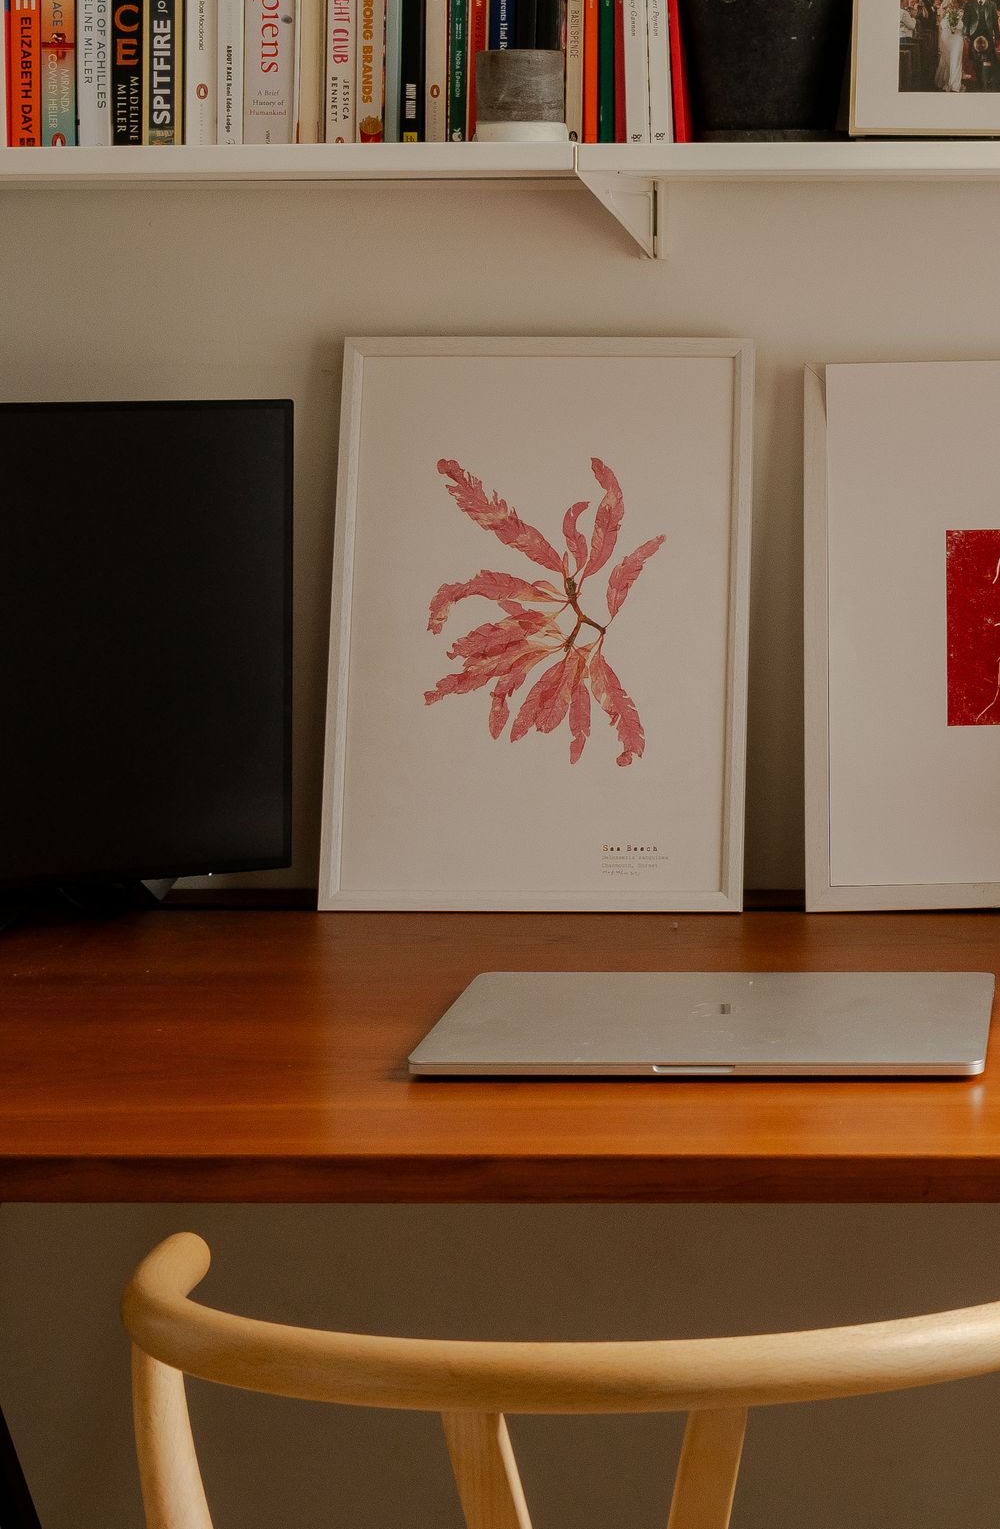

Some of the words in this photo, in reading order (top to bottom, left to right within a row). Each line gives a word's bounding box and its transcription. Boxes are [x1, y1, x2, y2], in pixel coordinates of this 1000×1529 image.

[97, 19, 106, 36] OF
[333, 28, 349, 64] CLUB
[20, 16, 32, 100] ELIZABETH
[84, 38, 93, 84] MILLER
[97, 42, 106, 109] ACHILLES
[153, 20, 171, 124] SPITFIRE
[362, 45, 372, 103] BRANDS
[21, 104, 32, 133] DAY
[117, 84, 127, 133] MILLER
[129, 76, 139, 141] MADELINE
